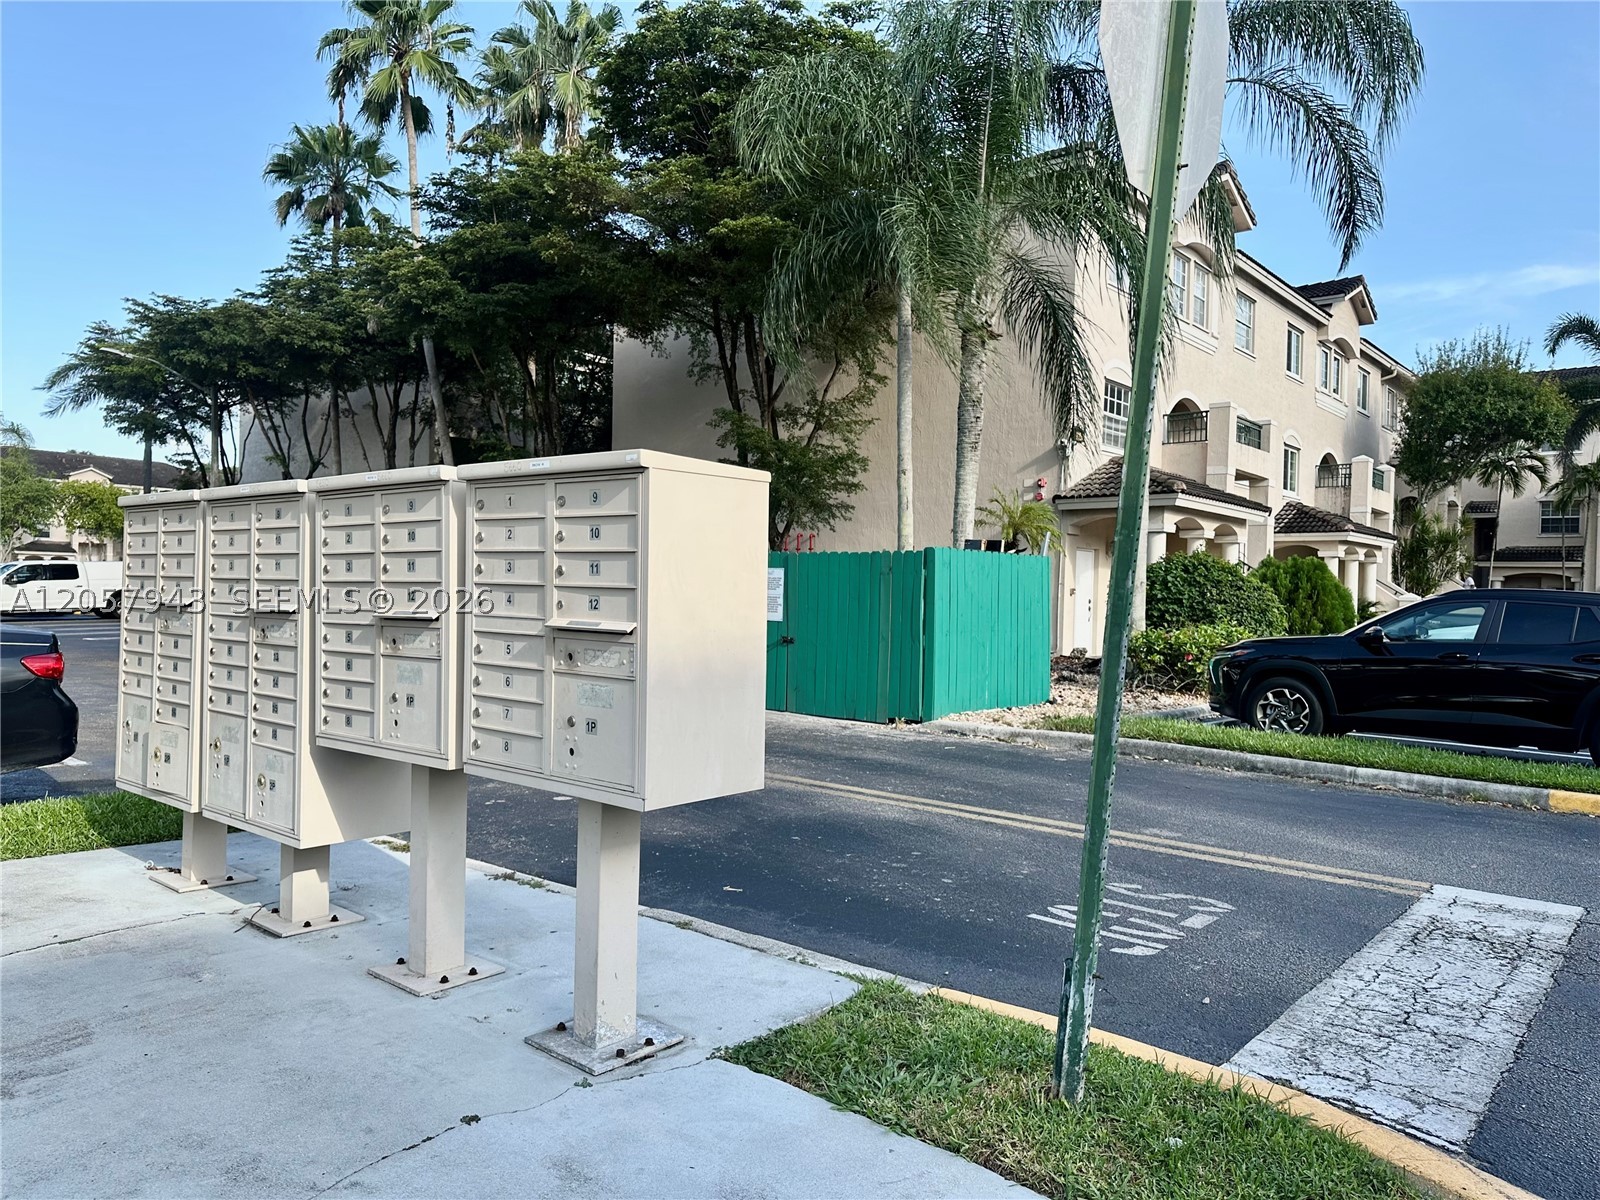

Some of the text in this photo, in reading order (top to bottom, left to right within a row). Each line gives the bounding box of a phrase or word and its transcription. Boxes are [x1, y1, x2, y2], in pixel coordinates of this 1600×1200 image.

[508, 496, 512, 507] 1
[592, 491, 598, 503] 9
[507, 529, 512, 540] 2
[590, 527, 600, 539] 10
[507, 562, 512, 572] 3
[590, 562, 599, 574] 11
[506, 594, 512, 605] 4
[589, 599, 599, 610] 12
[506, 644, 511, 655] 5
[505, 676, 510, 687] 6
[505, 708, 510, 719] 7
[586, 721, 596, 733] 1P
[504, 741, 509, 752] 8
